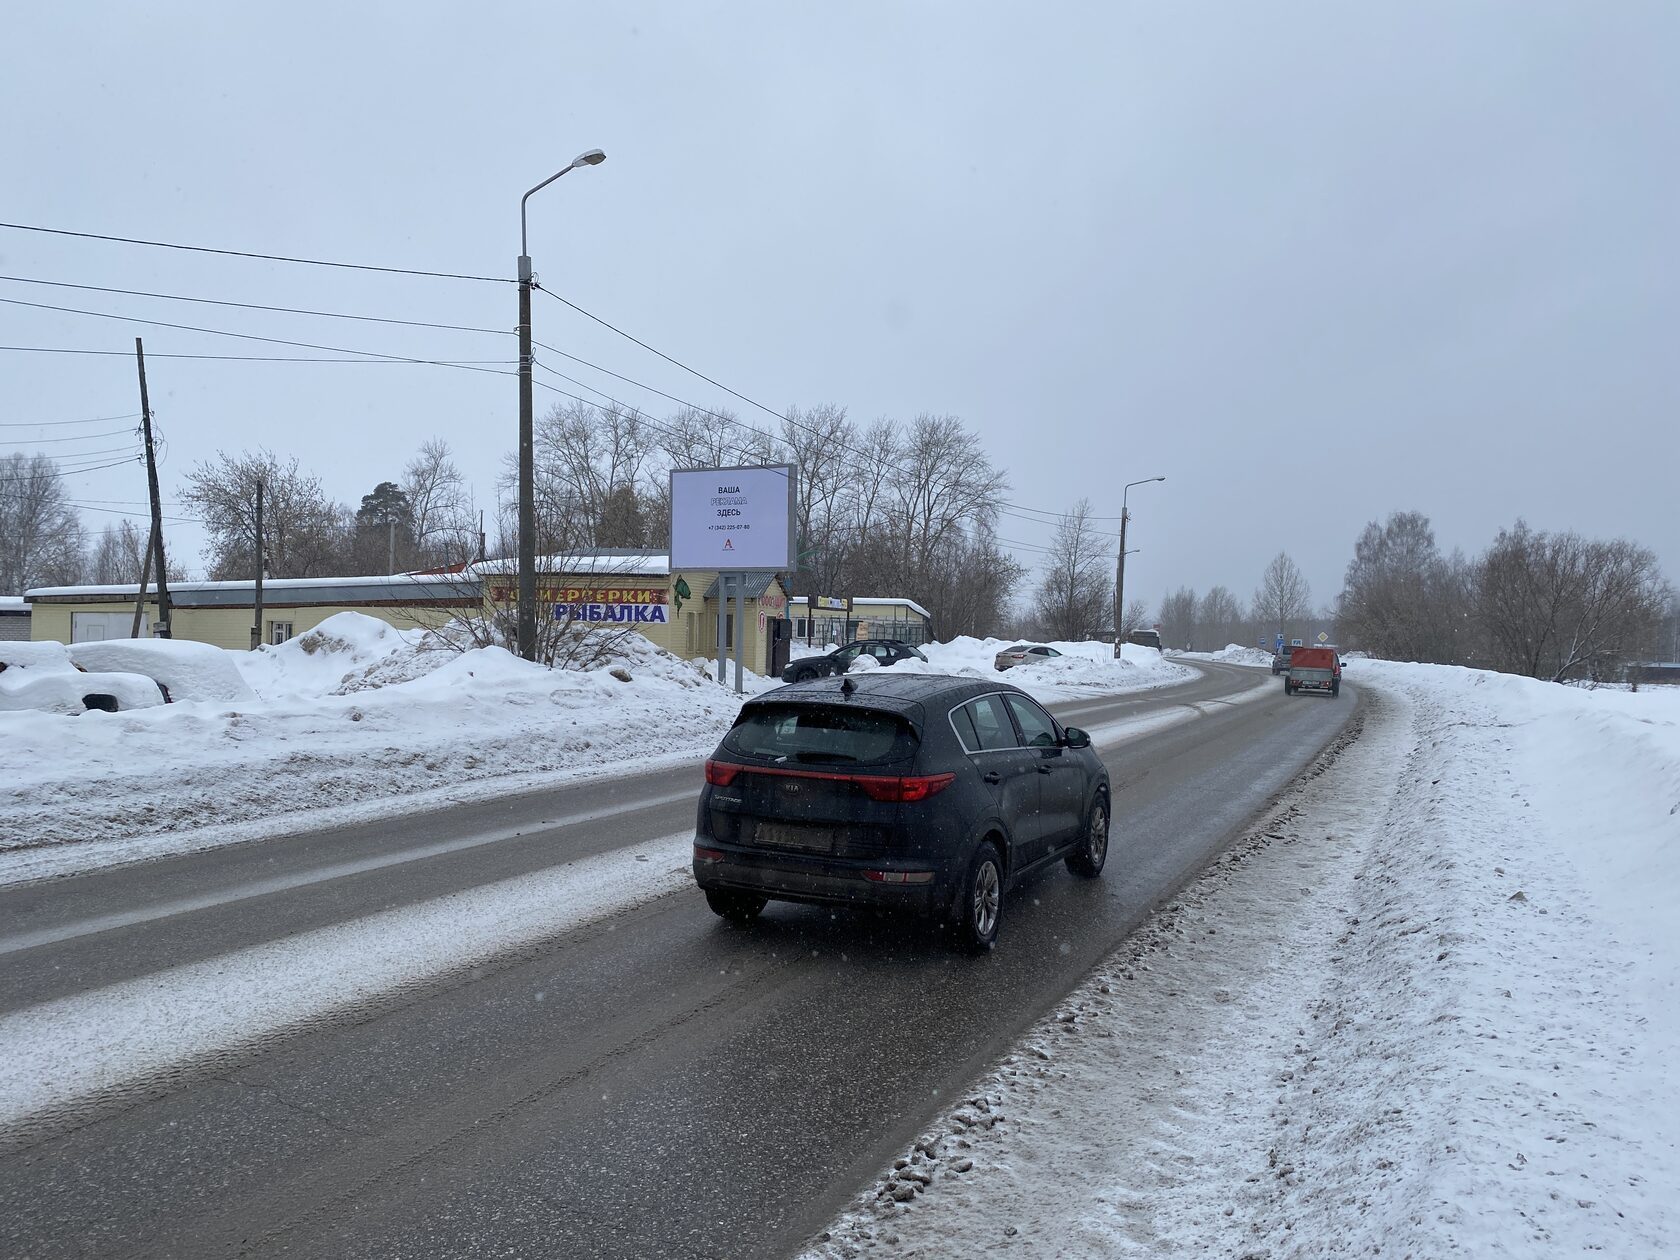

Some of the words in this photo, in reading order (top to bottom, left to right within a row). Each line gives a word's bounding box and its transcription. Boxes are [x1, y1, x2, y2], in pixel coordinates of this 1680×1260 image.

[718, 486, 740, 494] ВАША
[711, 497, 747, 506] РЕКЛАМА
[716, 509, 741, 517] ЗДЕСЬ
[555, 604, 666, 623] РЫБАЛКА
[785, 784, 799, 792] KIA
